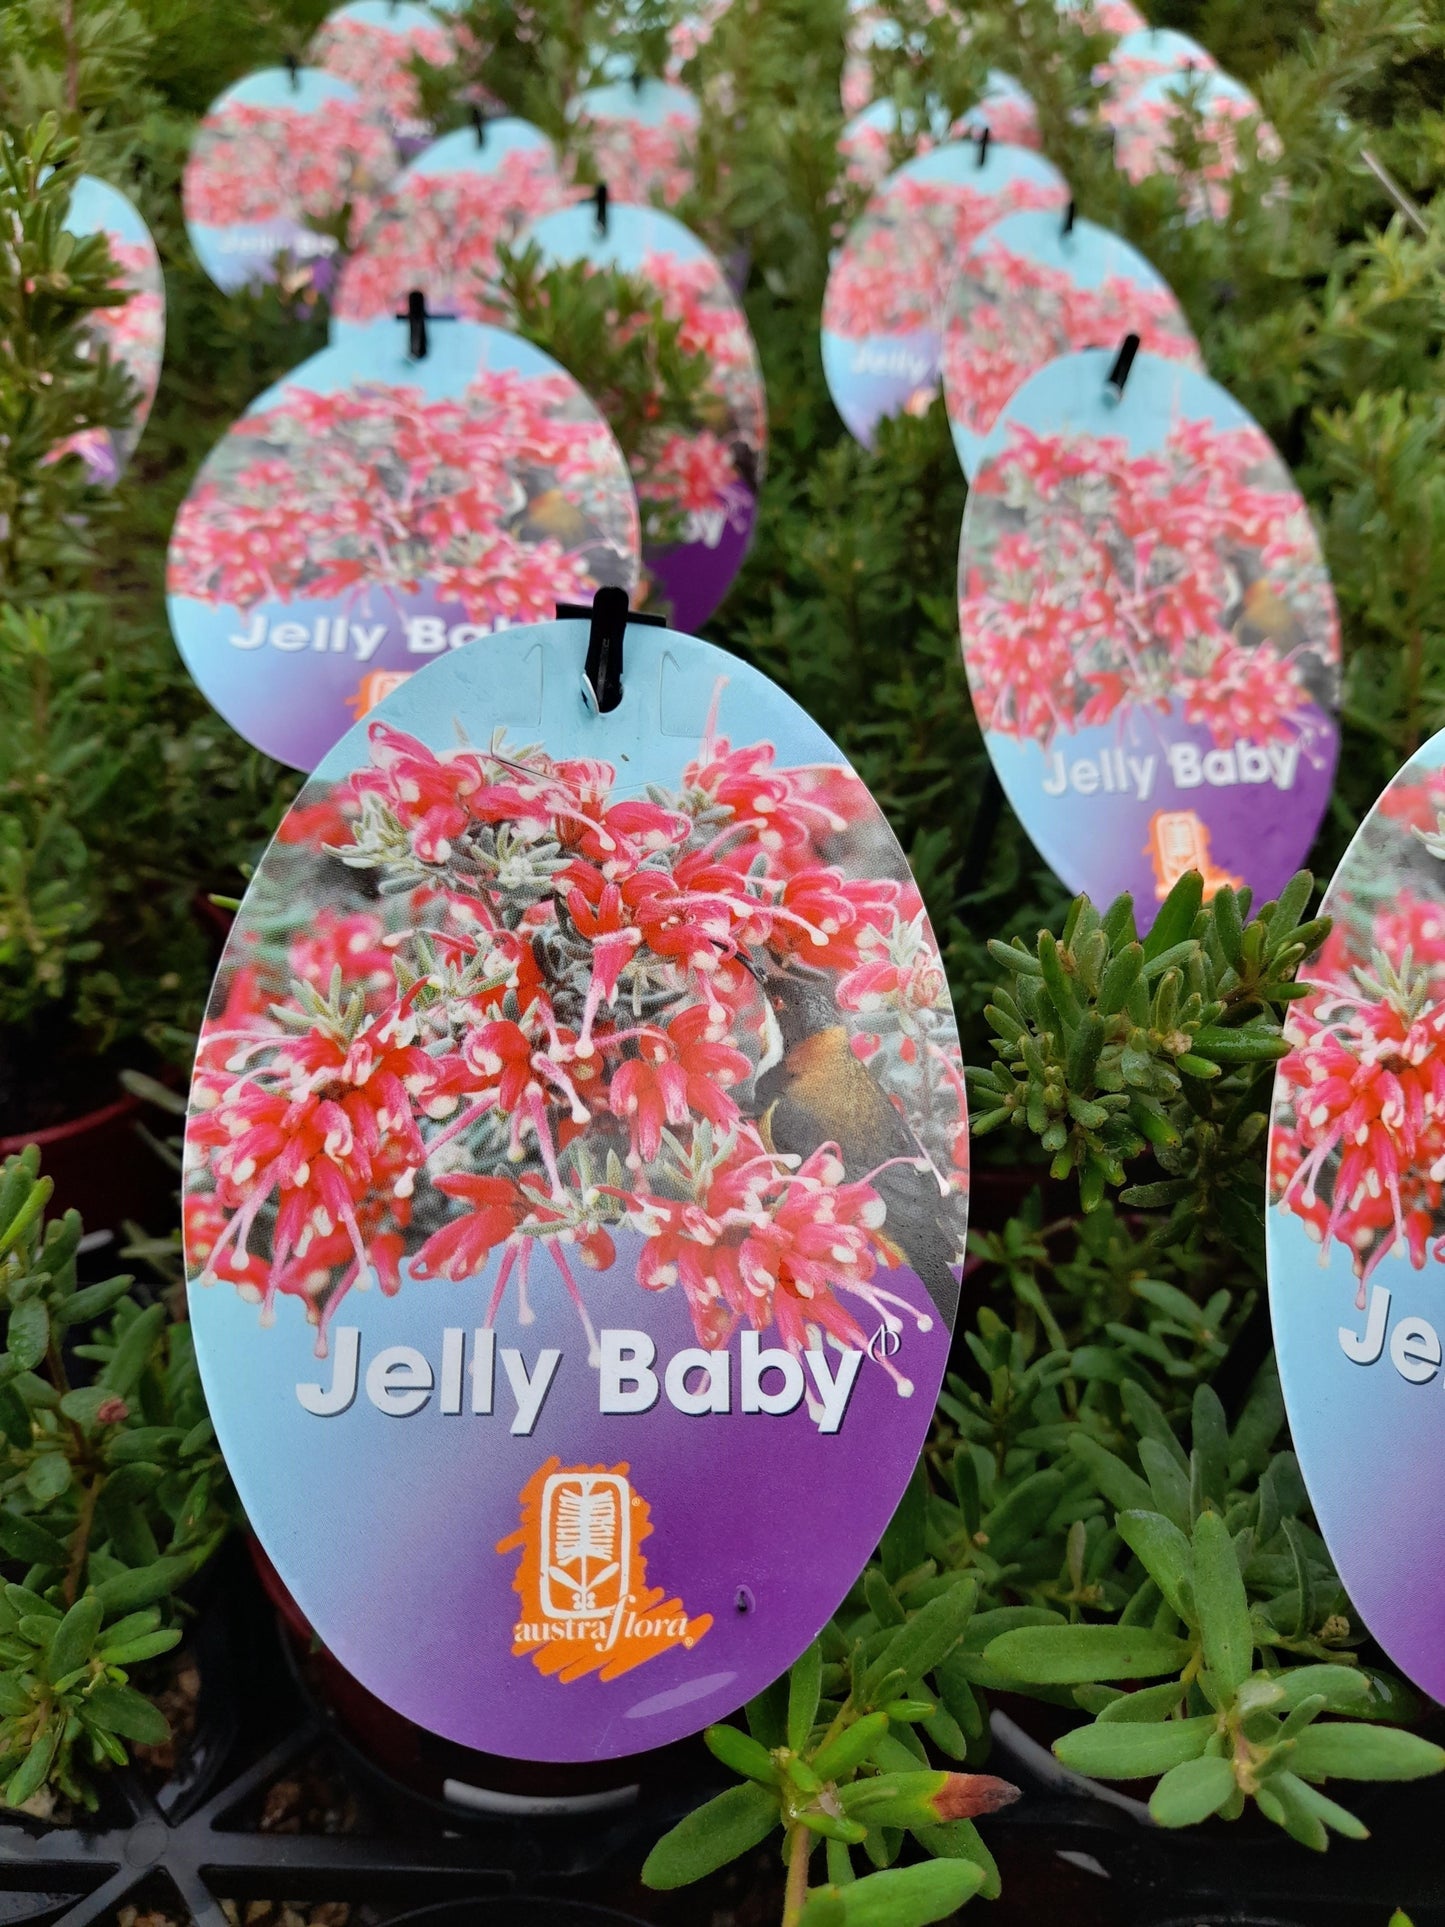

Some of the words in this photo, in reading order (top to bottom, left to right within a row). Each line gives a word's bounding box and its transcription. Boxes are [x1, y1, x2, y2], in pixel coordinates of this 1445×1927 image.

[229, 615, 389, 663] Jelly
[406, 614, 548, 653] Ba
[1042, 748, 1157, 801] Jelly
[1167, 738, 1300, 791] Baby
[1338, 1283, 1445, 1389] Je
[295, 1326, 564, 1437] Jelly
[599, 1328, 866, 1435] Baby
[514, 1594, 689, 1652] austraflora
